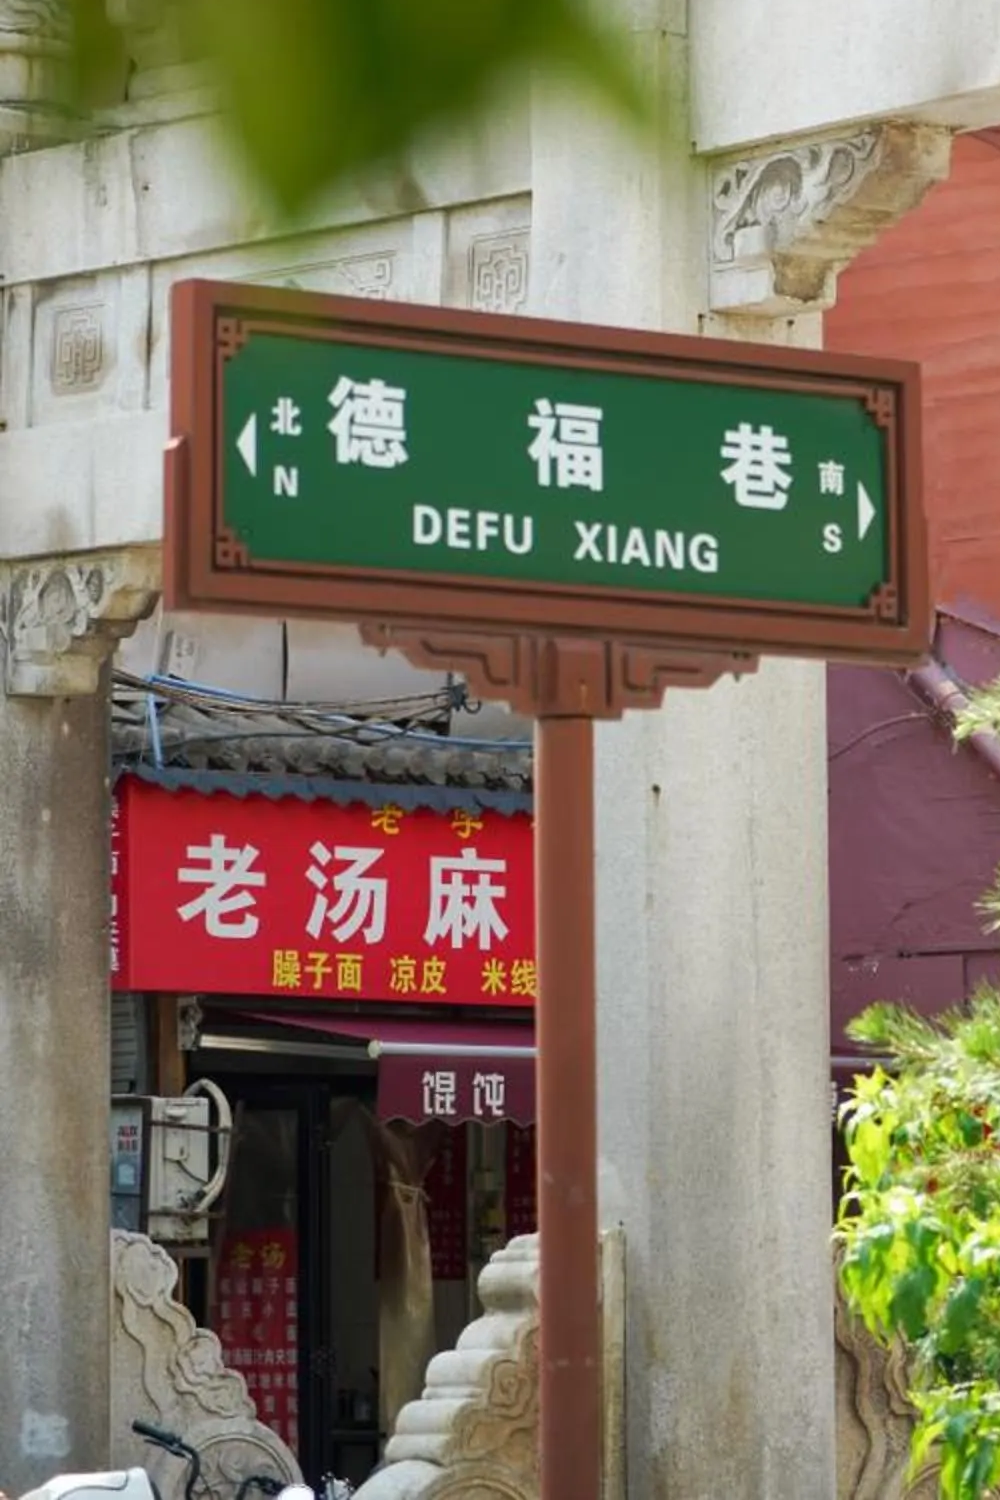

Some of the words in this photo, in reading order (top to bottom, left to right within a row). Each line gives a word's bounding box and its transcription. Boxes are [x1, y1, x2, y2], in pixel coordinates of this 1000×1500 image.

[270, 396, 302, 437] 北
[327, 375, 793, 511] 德福巷
[273, 465, 299, 498] N
[818, 459, 845, 497] 南
[412, 504, 534, 555] DEFU
[573, 521, 719, 574] XIANG
[822, 522, 843, 554] S
[176, 833, 510, 952] 老汤麻
[271, 948, 365, 993] 臊子面
[389, 953, 448, 995] 凉皮
[480, 957, 540, 997] 米线
[421, 1070, 506, 1117] 馄饨
